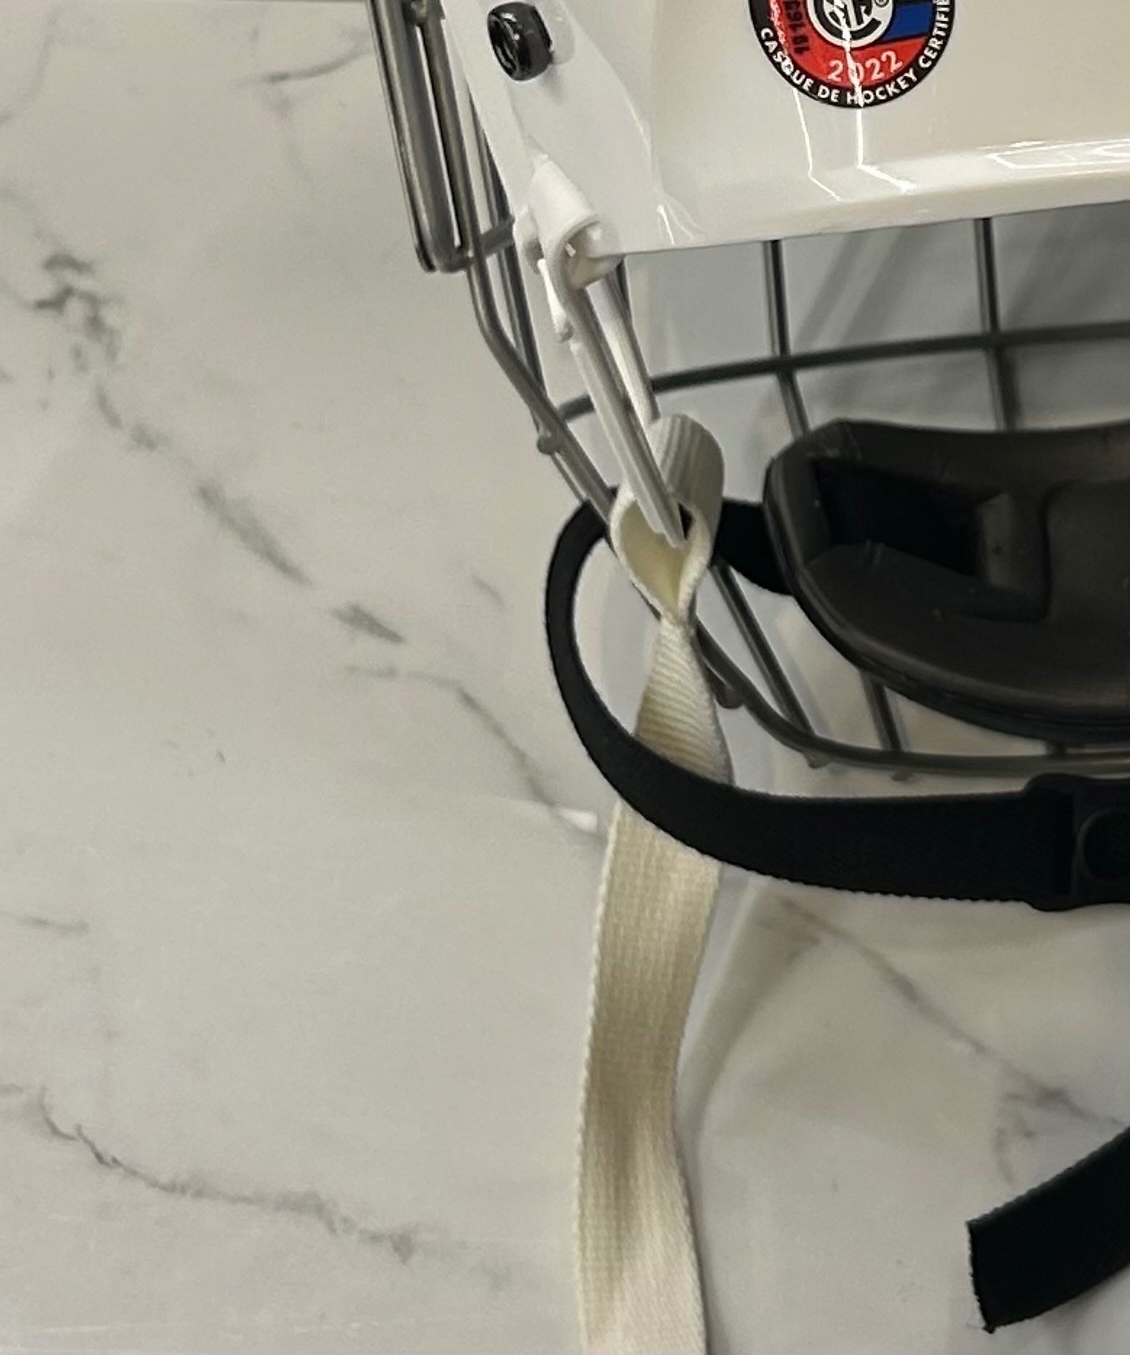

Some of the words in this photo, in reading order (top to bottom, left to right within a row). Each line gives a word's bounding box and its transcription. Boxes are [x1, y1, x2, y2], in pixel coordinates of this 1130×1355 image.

[760, 27, 815, 91] CASQUE
[817, 84, 839, 103] DE
[846, 67, 918, 105] HOCKEY
[828, 51, 903, 82] 2022
